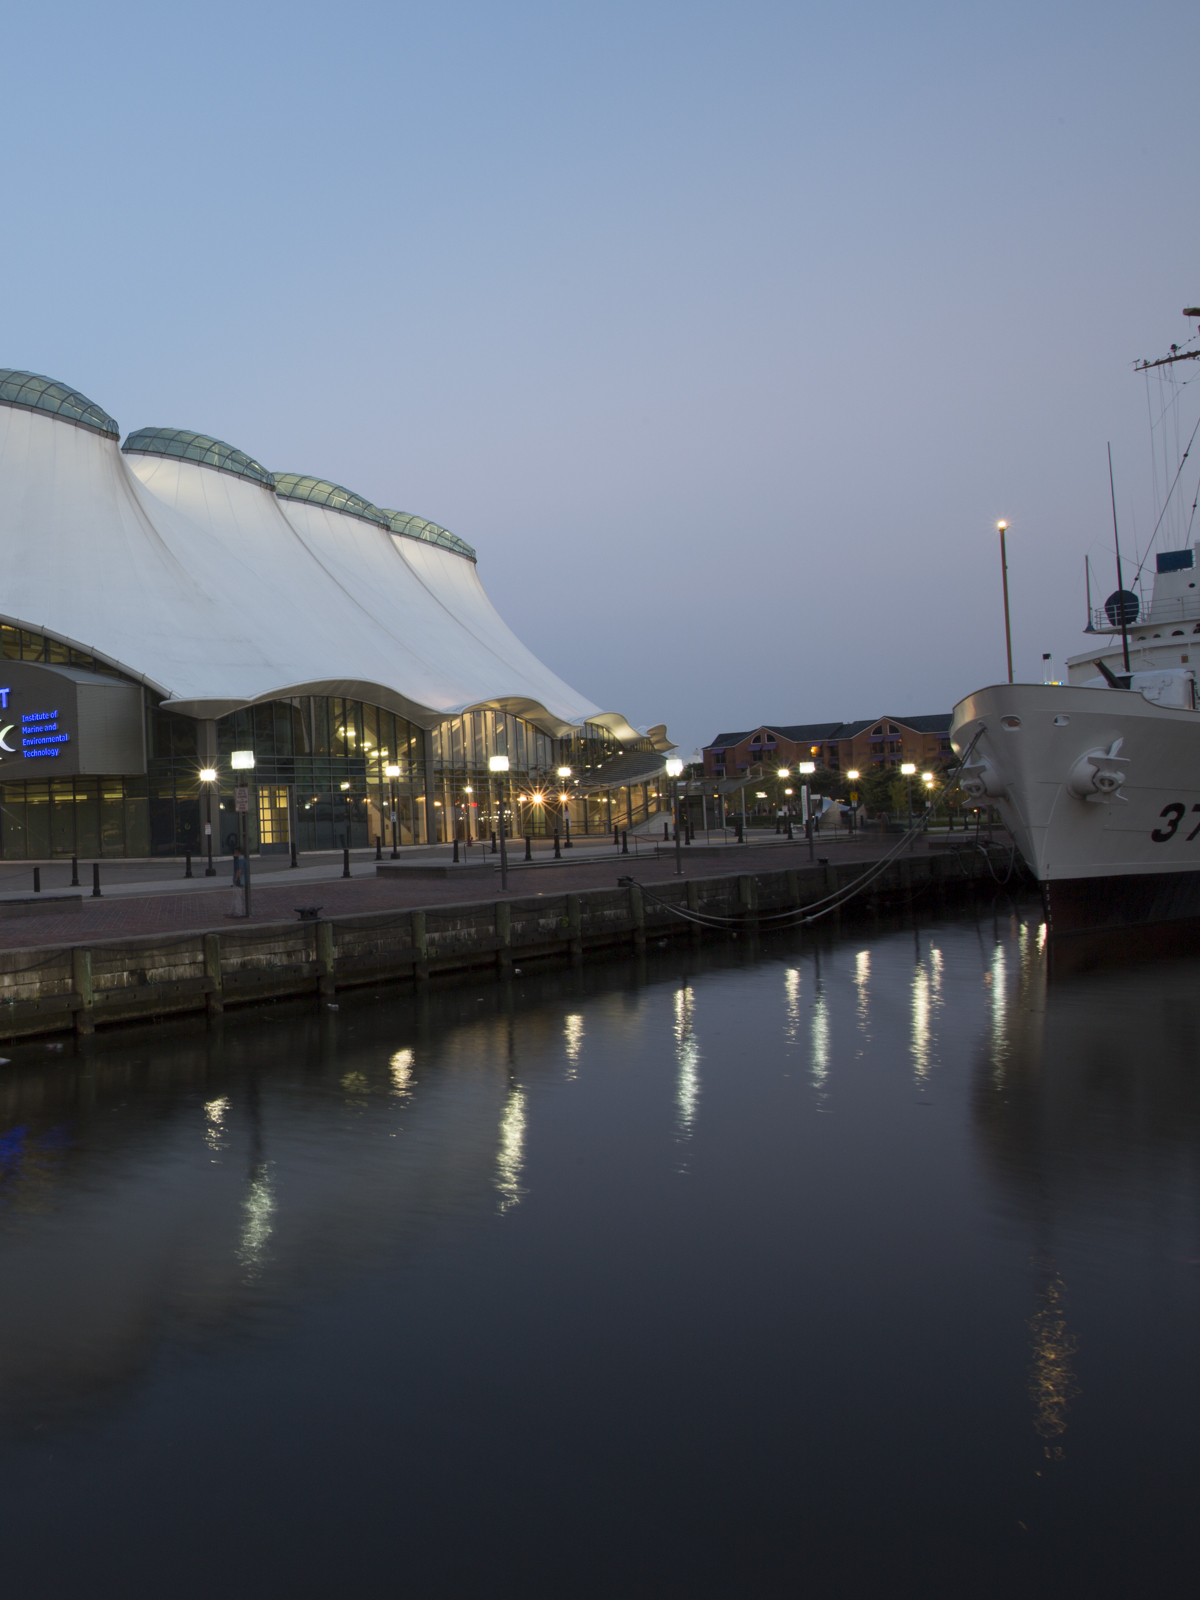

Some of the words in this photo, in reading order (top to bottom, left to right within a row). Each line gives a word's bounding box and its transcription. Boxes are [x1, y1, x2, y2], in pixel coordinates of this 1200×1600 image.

[21, 711, 50, 723] Institute
[50, 709, 58, 719] of
[22, 724, 44, 734] Marine
[44, 722, 57, 732] and
[22, 733, 68, 746] Environmental
[23, 747, 59, 758] Technology
